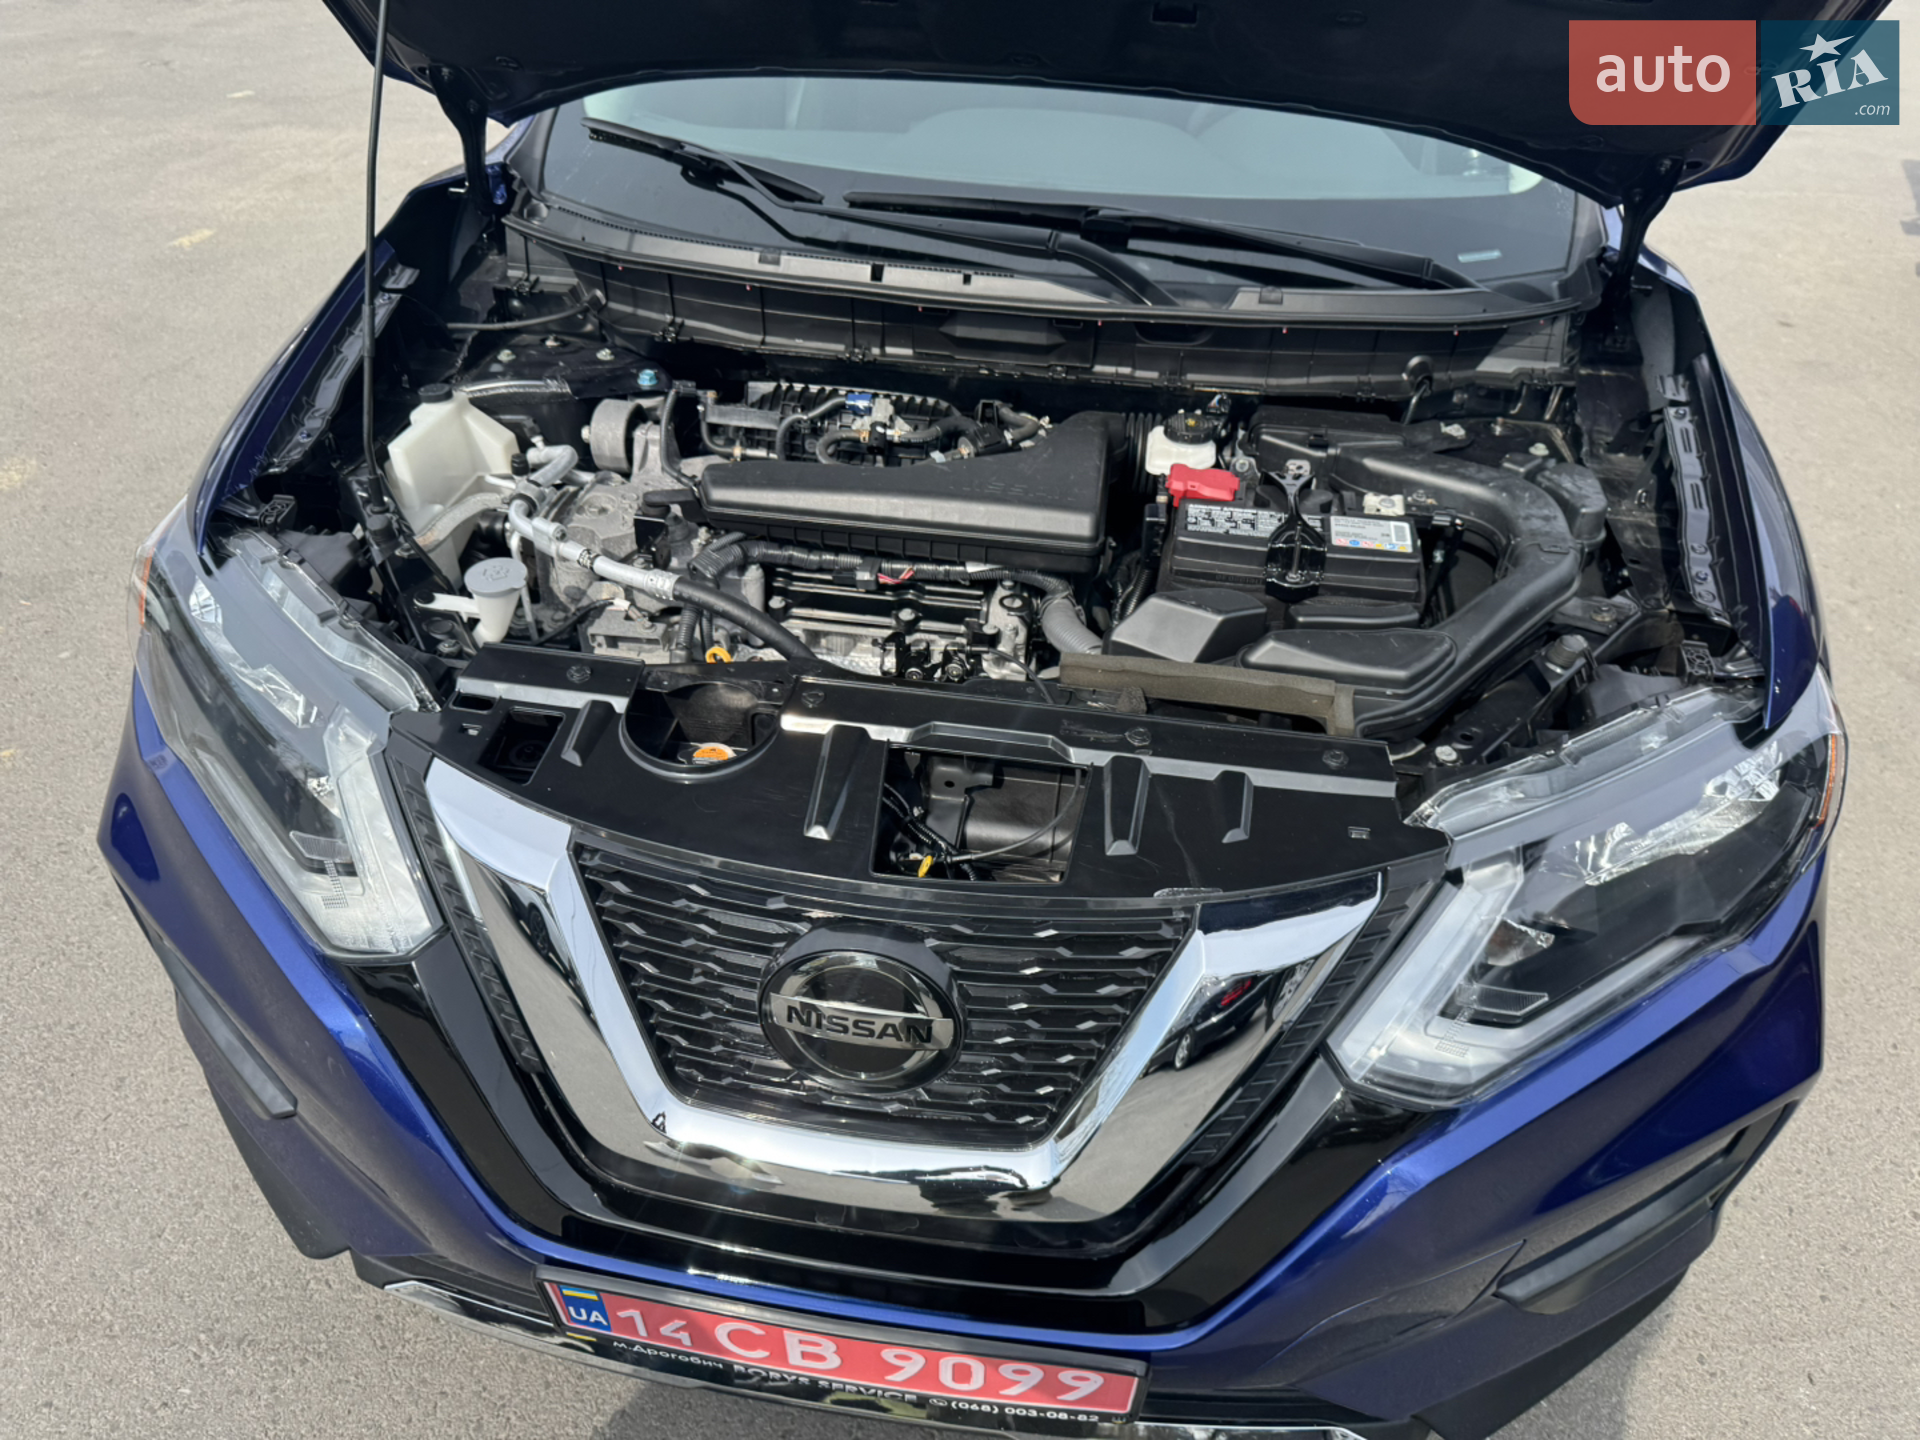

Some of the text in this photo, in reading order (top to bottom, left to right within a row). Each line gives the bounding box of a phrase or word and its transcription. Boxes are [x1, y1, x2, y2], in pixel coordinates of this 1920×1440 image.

[787, 1005, 932, 1044] NISSAN
[568, 1306, 608, 1325] UA
[617, 1309, 1105, 1401] 14 CB 9099
[733, 1364, 918, 1403] BORYS SERVICE
[951, 1400, 1100, 1422] (068) 003-08-82
